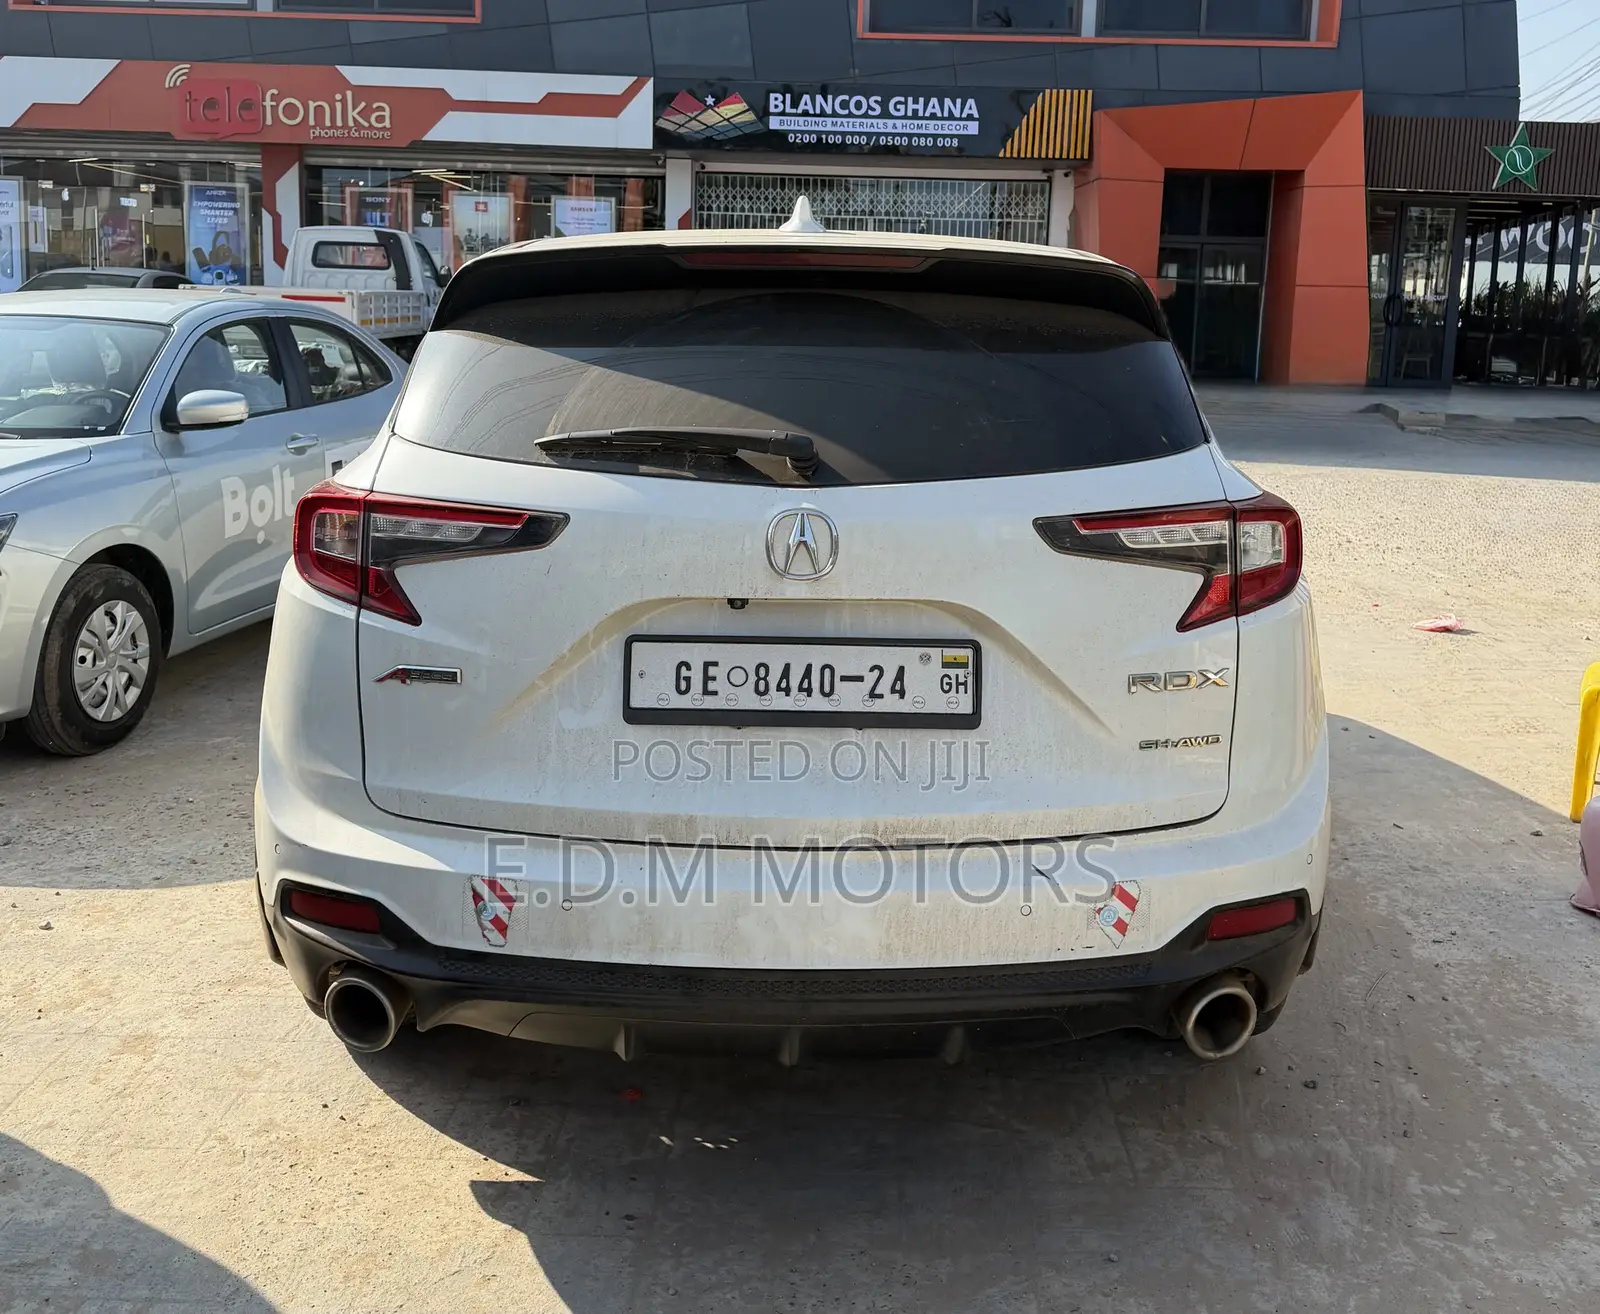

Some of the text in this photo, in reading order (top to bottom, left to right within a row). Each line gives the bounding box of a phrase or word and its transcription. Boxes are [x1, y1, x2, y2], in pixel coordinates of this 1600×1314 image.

[184, 86, 392, 129] telefonika
[769, 92, 980, 118] BLANCOS GHANA
[310, 126, 349, 140] phones
[361, 130, 391, 139] more
[779, 119, 828, 129] BUILDING
[831, 120, 889, 130] MATERIALS
[901, 123, 931, 131] HOME
[933, 123, 969, 132] DECOR
[787, 133, 959, 148] 0200 100 000 / 0500 080 008
[192, 200, 241, 209] EMPOWERING
[365, 196, 392, 204] SONY
[200, 208, 235, 217] SMARTER
[206, 216, 229, 224] LIVES
[220, 464, 296, 545] Bolt
[674, 660, 907, 700] GE 8440-24
[939, 673, 969, 696] GH
[1127, 667, 1230, 695] RDX
